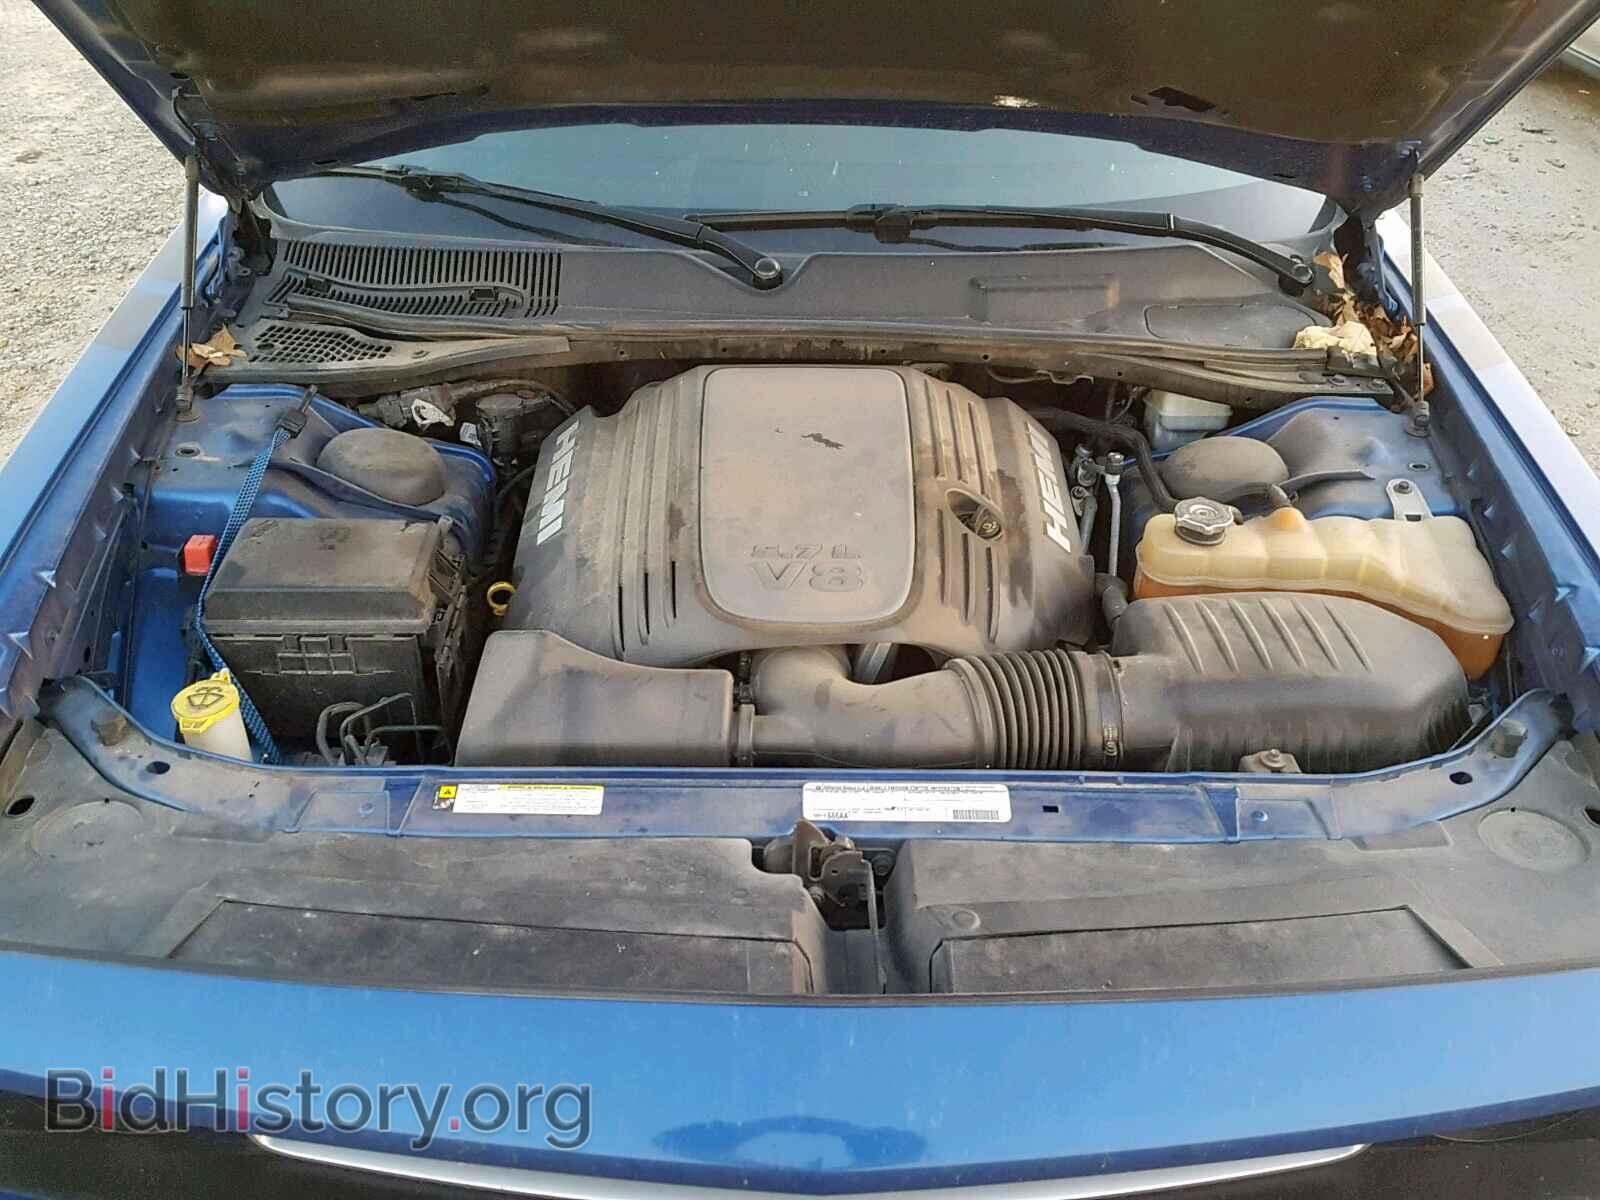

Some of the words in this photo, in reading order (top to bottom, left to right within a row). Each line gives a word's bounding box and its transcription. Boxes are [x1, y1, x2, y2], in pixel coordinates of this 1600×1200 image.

[536, 422, 579, 545] HEMI
[1026, 422, 1070, 553] HEMI
[747, 560, 864, 593] V8
